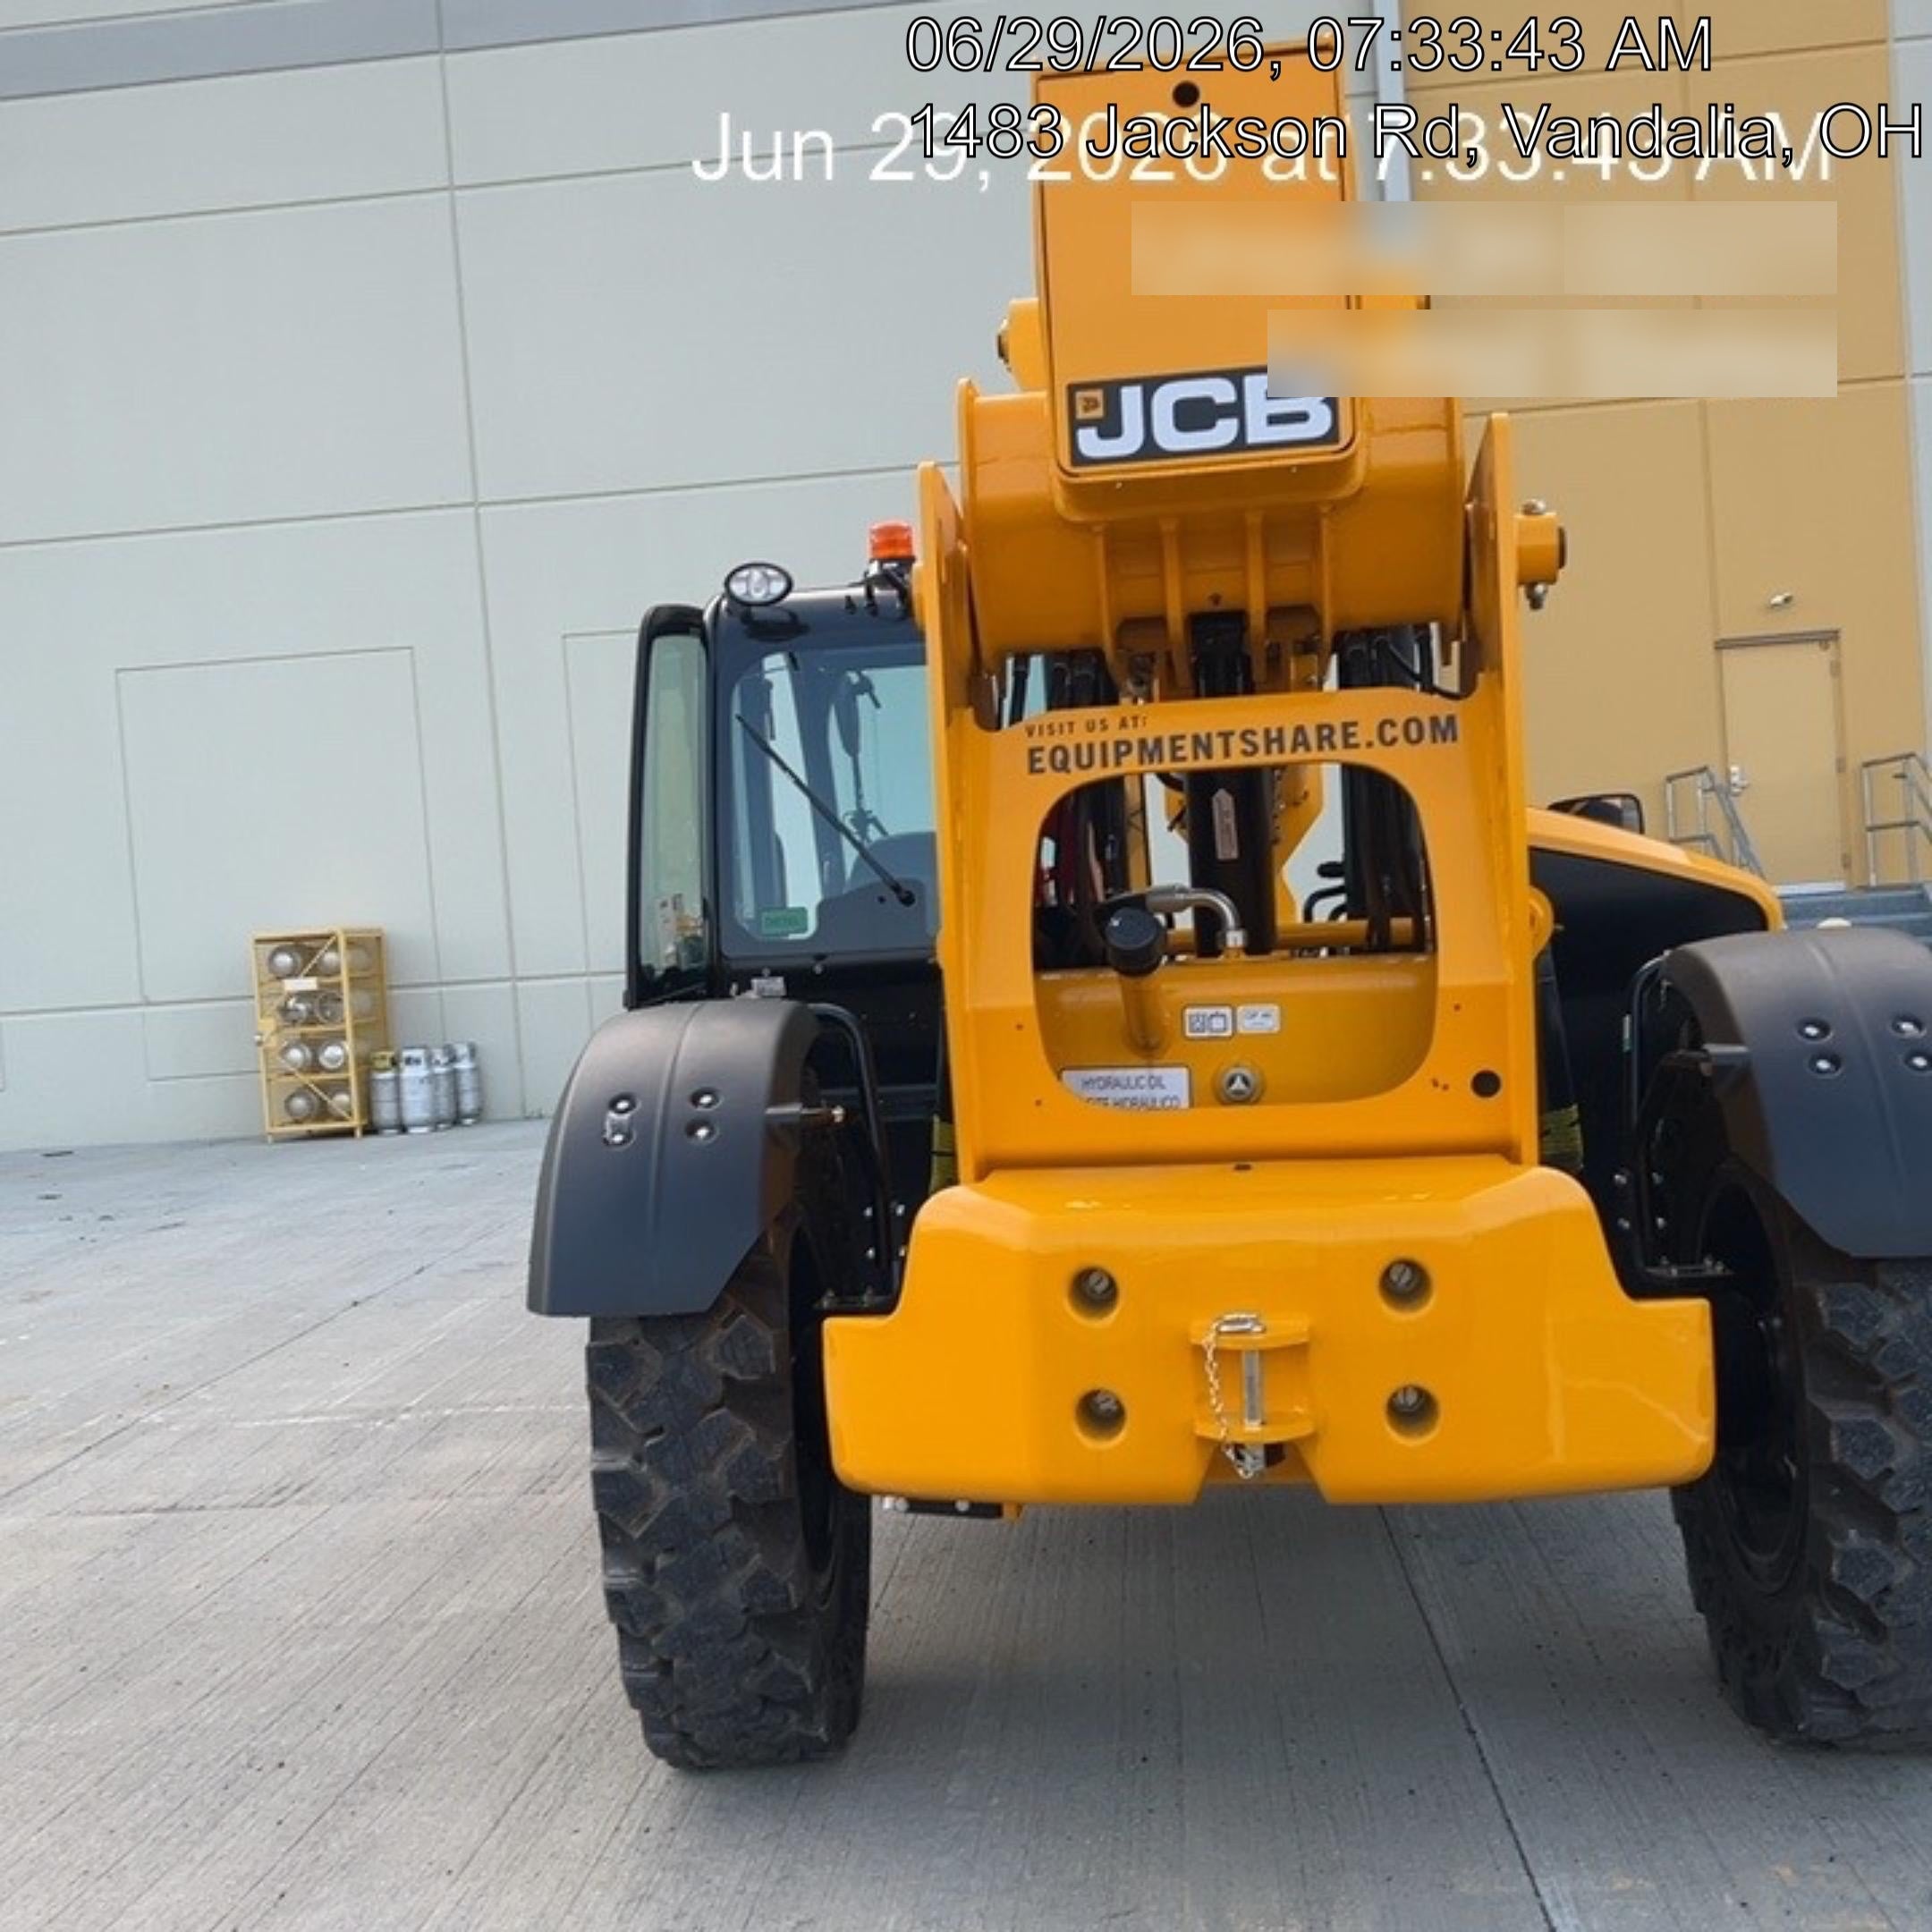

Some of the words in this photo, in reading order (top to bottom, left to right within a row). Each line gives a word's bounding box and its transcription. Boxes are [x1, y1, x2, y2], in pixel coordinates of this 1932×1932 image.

[1076, 374, 1334, 459] JCB
[1026, 723, 1074, 737] VISIT
[1086, 719, 1109, 733] US
[1029, 715, 1458, 774] EQUIPMENTSHARE.COM
